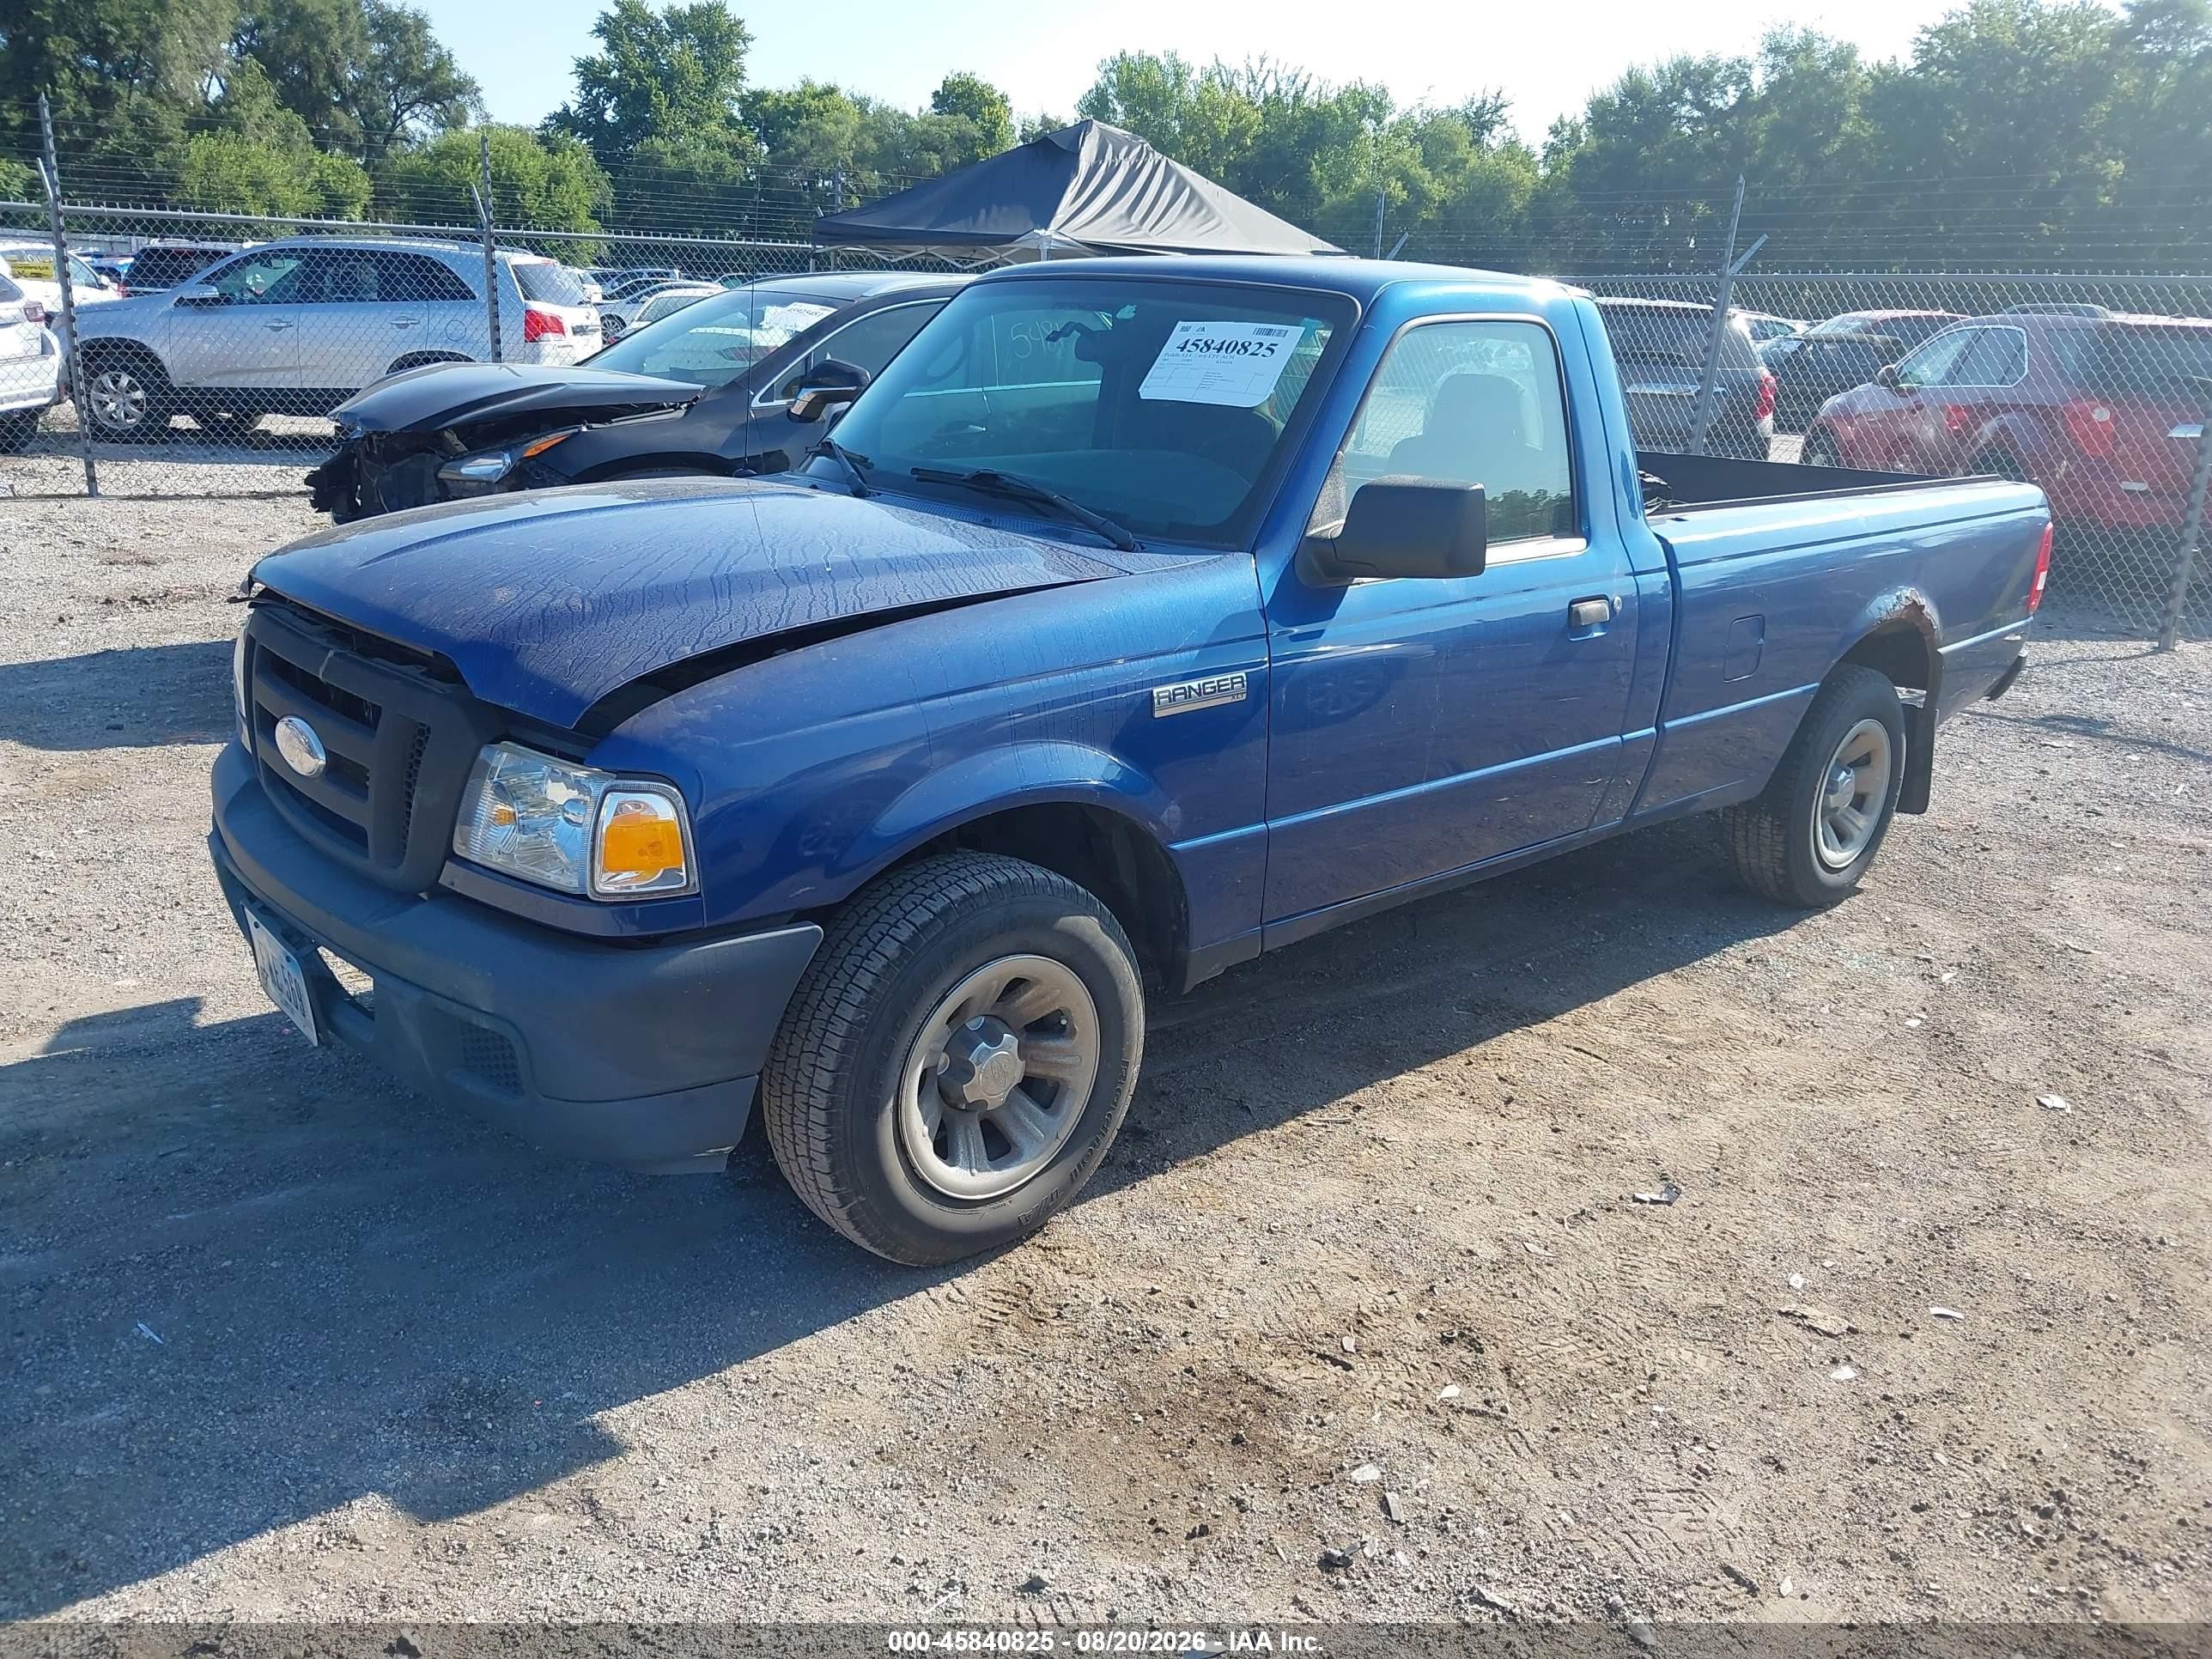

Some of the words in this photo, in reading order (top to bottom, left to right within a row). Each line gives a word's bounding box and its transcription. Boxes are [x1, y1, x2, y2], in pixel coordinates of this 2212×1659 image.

[1176, 337, 1279, 358] 45840825
[1156, 676, 1245, 705] RANGER
[1231, 693, 1244, 702] XLT
